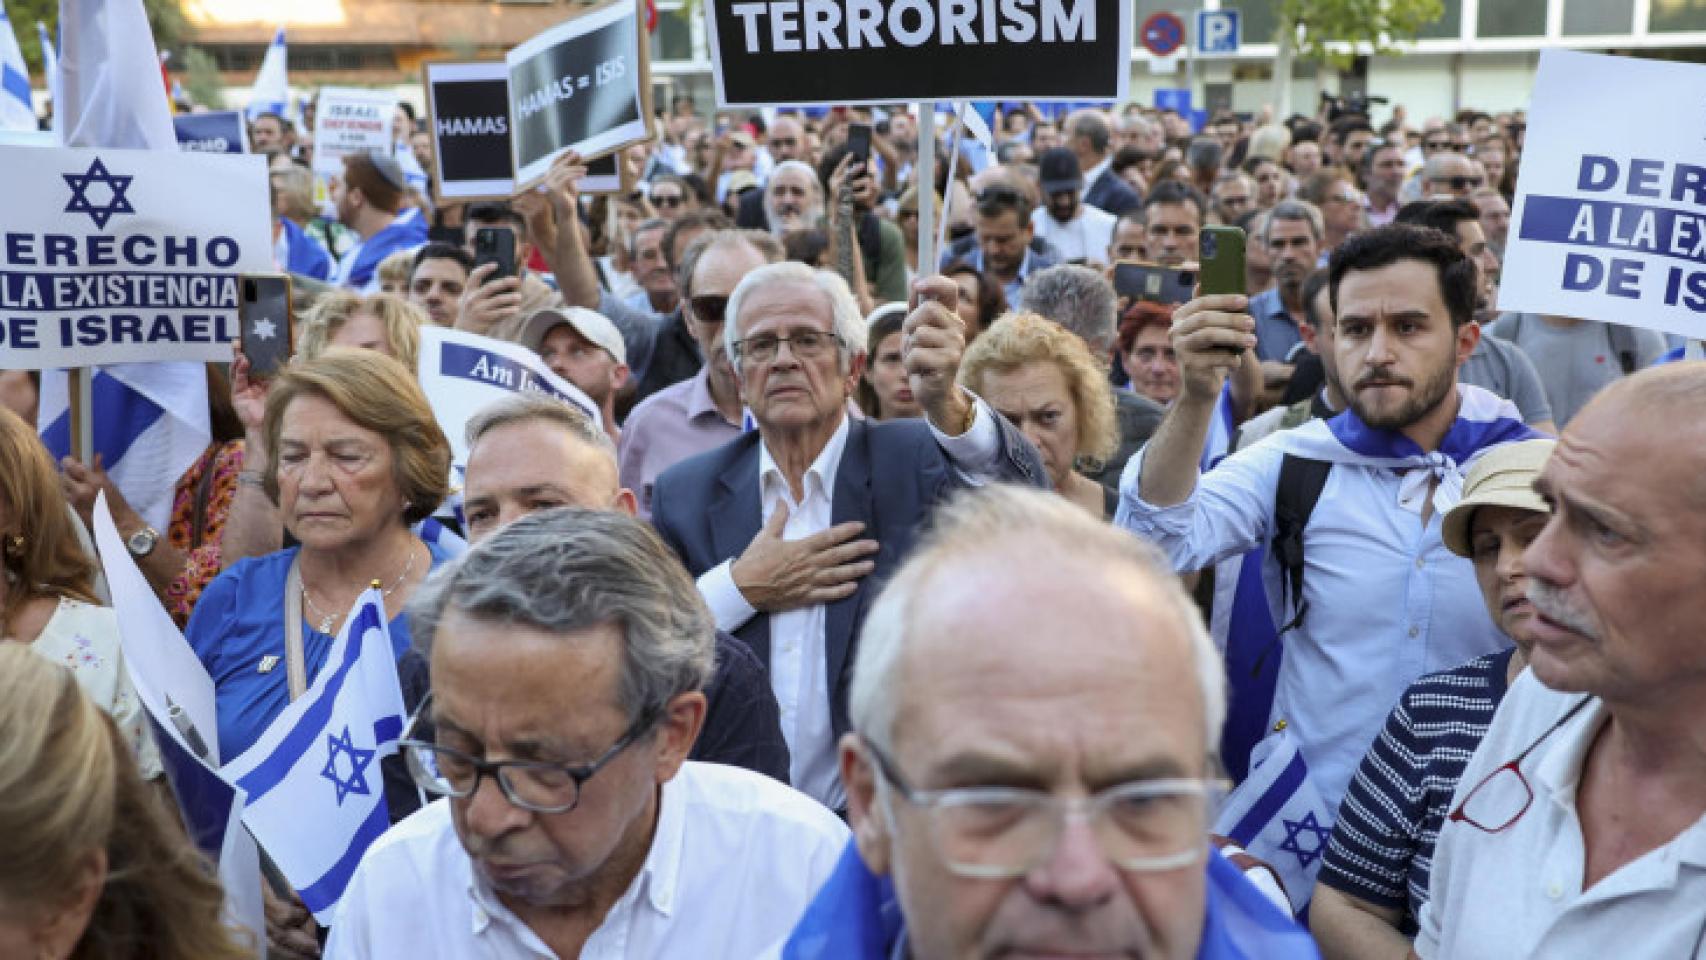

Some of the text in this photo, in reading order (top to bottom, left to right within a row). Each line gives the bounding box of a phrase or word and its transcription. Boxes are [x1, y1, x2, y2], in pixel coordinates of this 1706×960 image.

[732, 0, 1097, 52] TERRORISM
[1204, 15, 1231, 48] P
[518, 76, 574, 119] HAMAS
[595, 56, 625, 87] ISIS
[438, 116, 507, 136] HAMAS
[1577, 154, 1706, 206] DER
[1568, 203, 1595, 242] A
[1608, 207, 1658, 249] LA
[6, 233, 240, 267] ERECHO
[0, 275, 238, 307] LA EXISTENCIA
[1562, 252, 1706, 313] DE IS
[0, 315, 240, 349] E ISRAEL
[469, 355, 513, 386] Am
